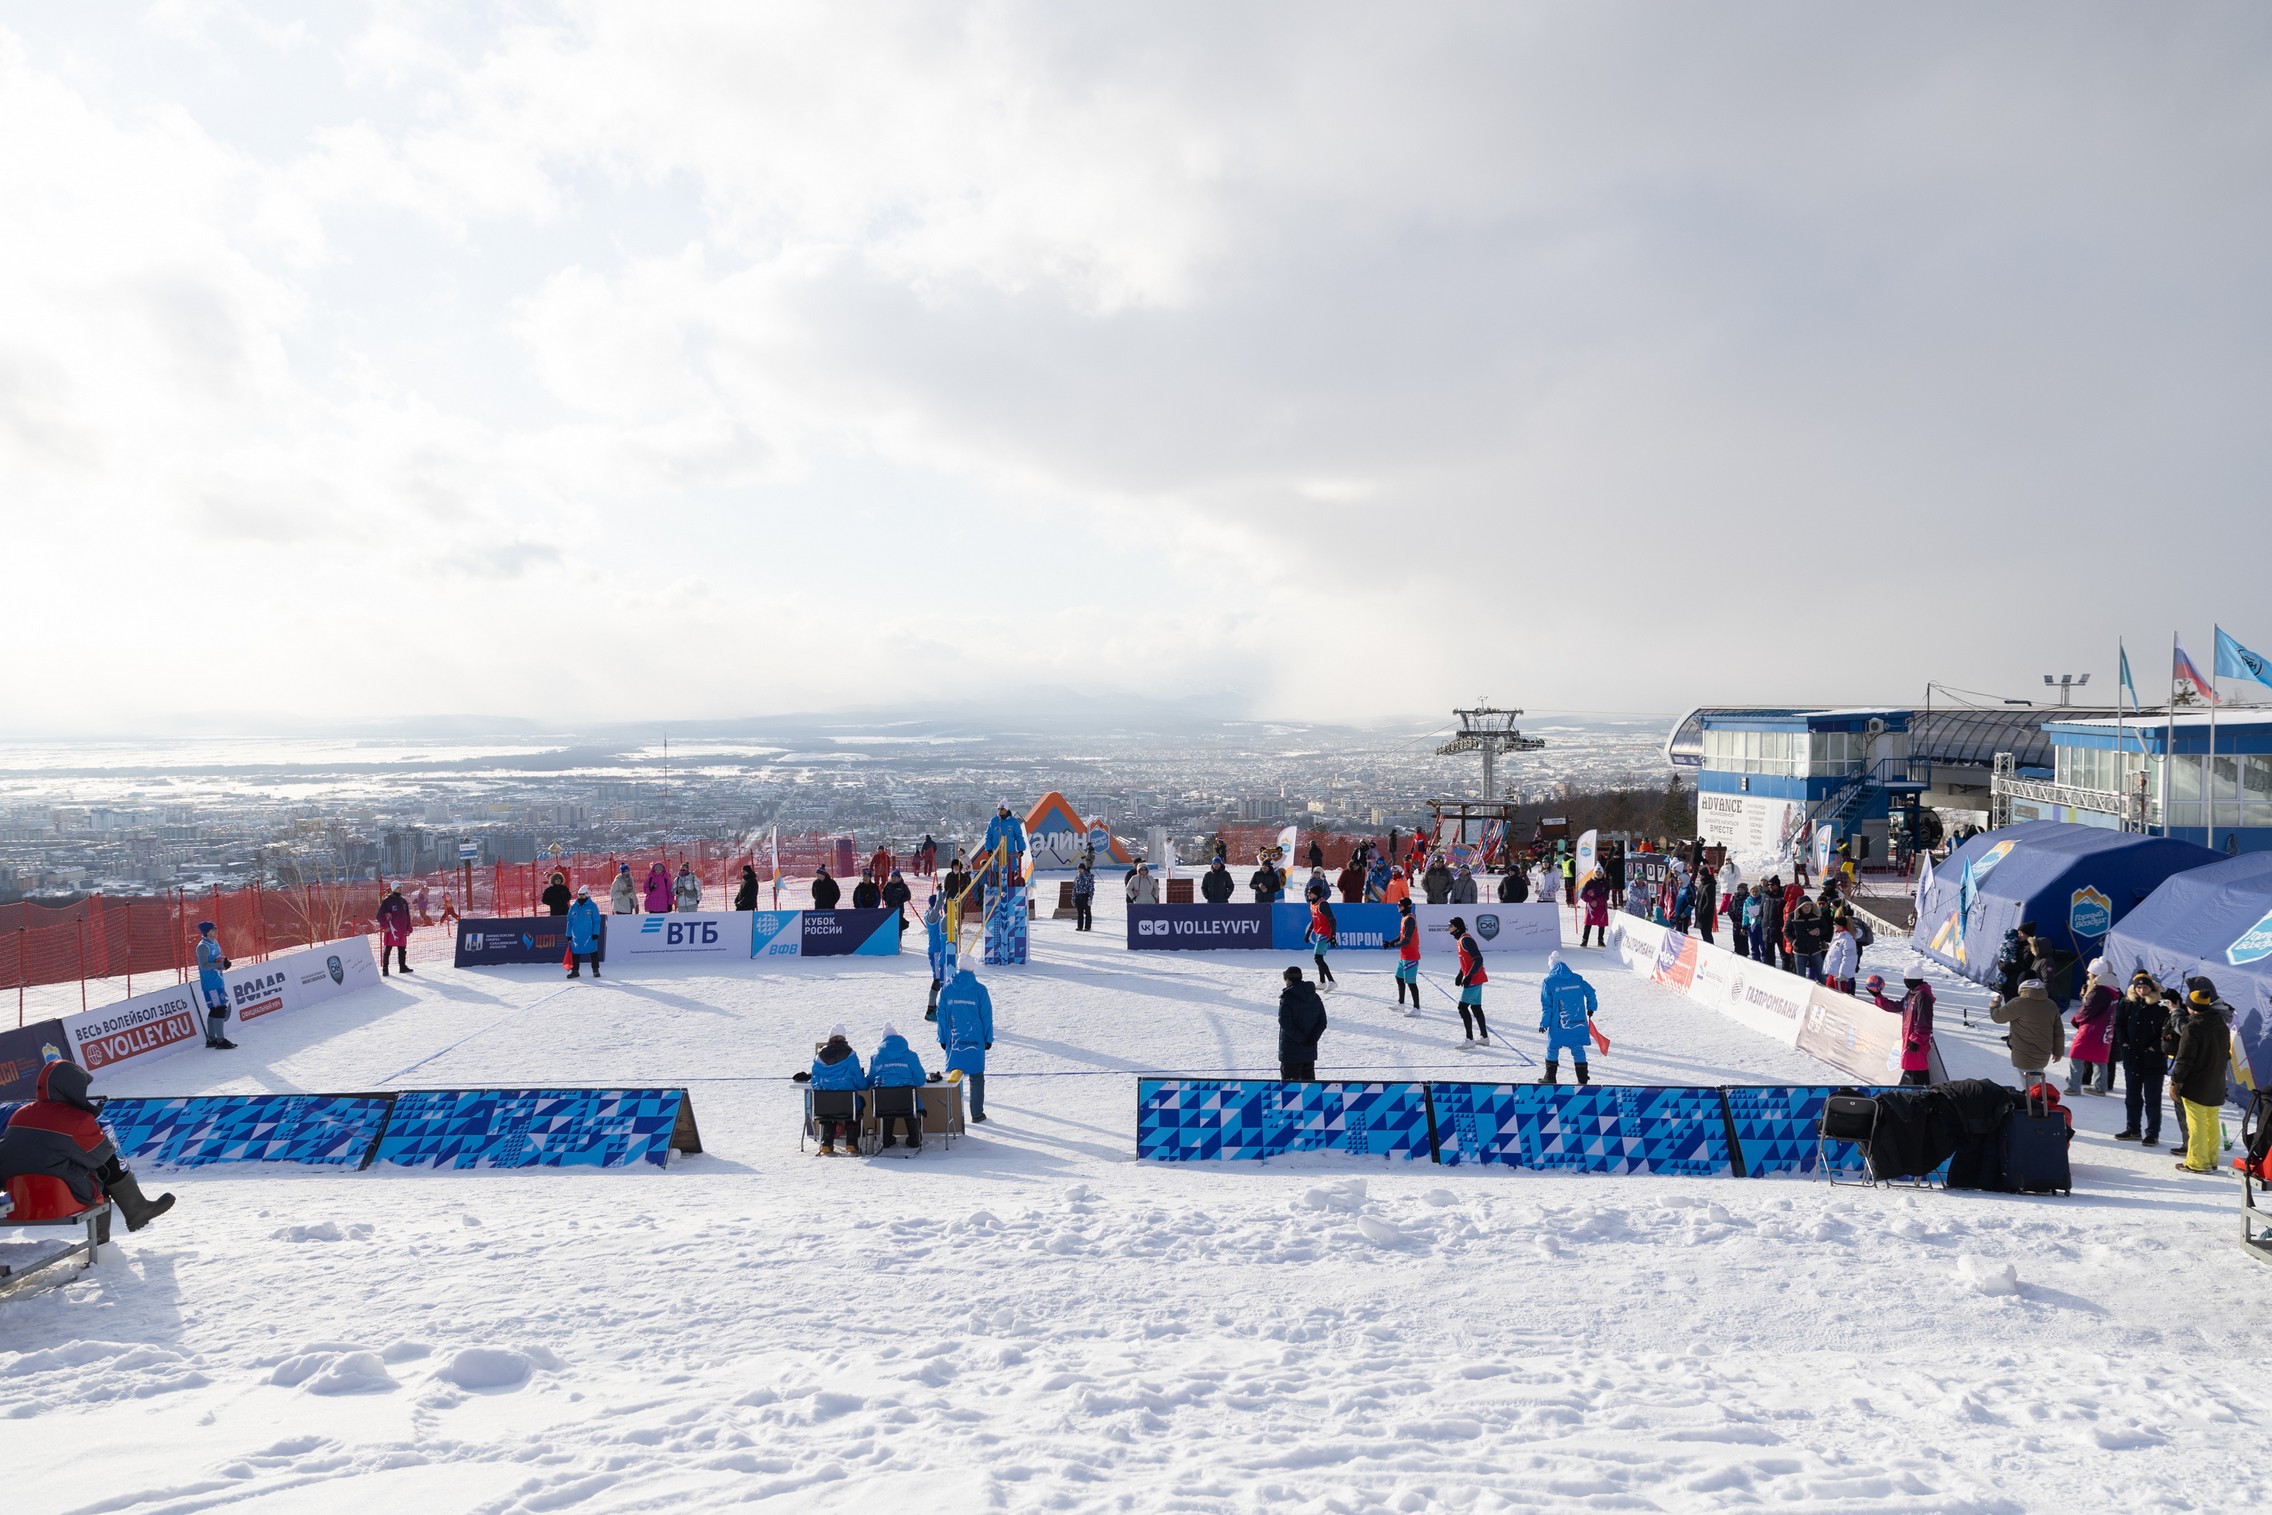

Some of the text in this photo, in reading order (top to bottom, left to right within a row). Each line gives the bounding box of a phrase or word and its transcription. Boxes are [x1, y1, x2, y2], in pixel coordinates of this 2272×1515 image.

[1702, 797, 1742, 813] ADVANCE
[1710, 825, 1733, 835] ВМЕСТЕ
[805, 917, 835, 926] КУБОК
[1174, 920, 1260, 935] VOLLEYVFV
[667, 921, 718, 945] ВТБ
[805, 926, 842, 935] РОССИИ
[536, 934, 555, 949] ЦСП
[1335, 932, 1383, 946] АЗПРОМ
[769, 944, 799, 956] ВФВ
[1745, 986, 1800, 1020] ГАЗПРОМБАНК
[76, 999, 188, 1041] ВЕСЬ ВОЛЕЙБОЛ ЗДЕСЬ
[101, 1016, 191, 1060] VOLLEY.RU
